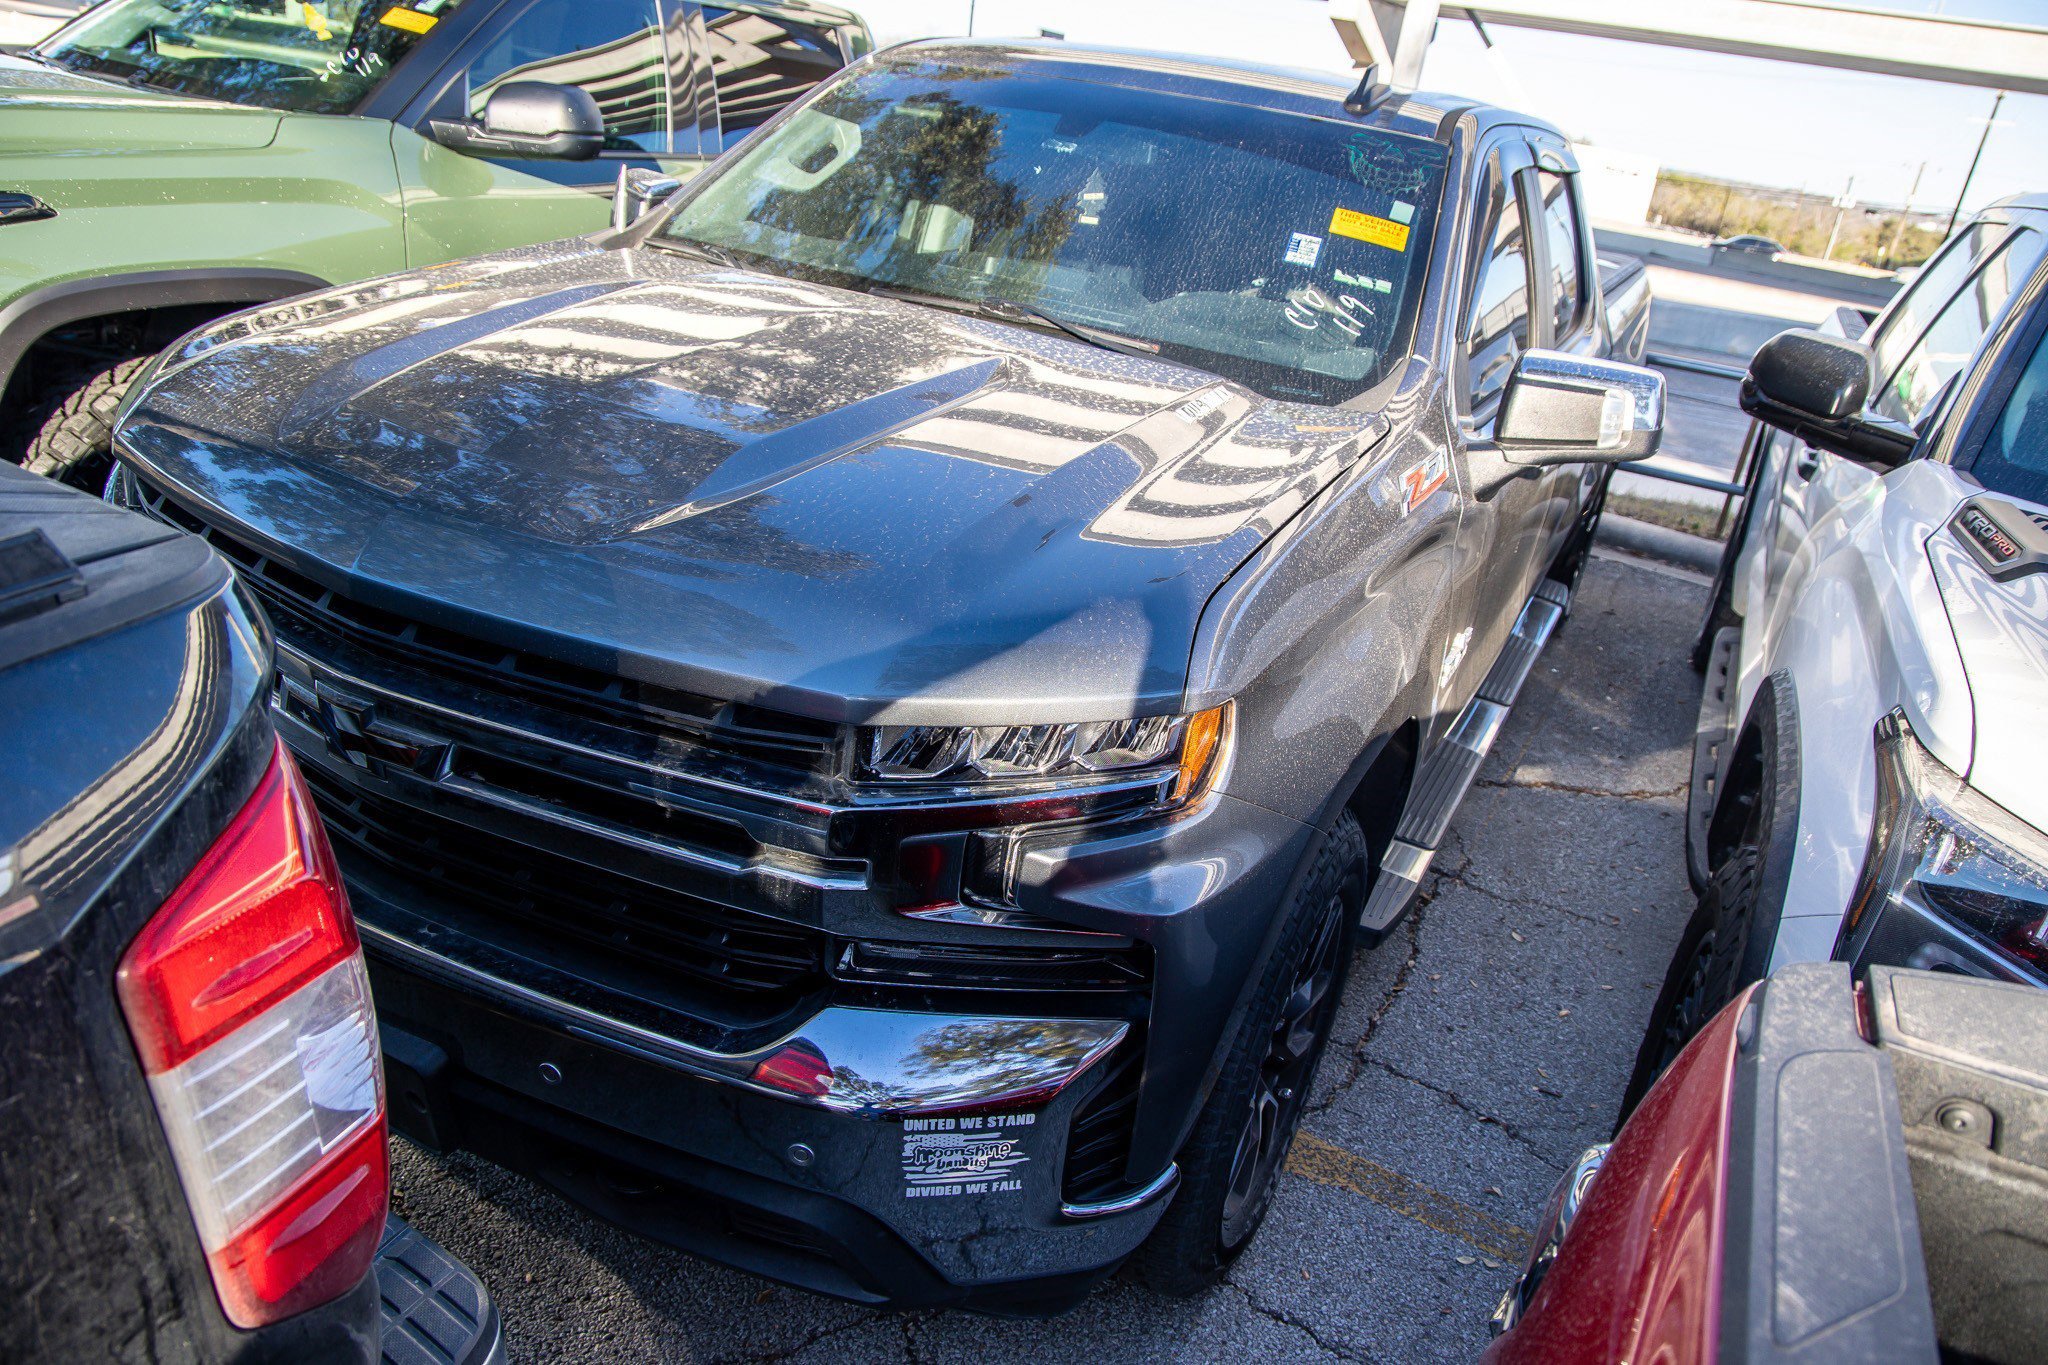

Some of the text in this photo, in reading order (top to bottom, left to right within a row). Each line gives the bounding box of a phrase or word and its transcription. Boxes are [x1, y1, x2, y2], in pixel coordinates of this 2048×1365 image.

[1340, 211, 1406, 232] THIS VEHICLE
[1379, 227, 1402, 237] SALE
[1990, 533, 2016, 557] PRO
[903, 1113, 1036, 1131] UNITED WE STAND
[905, 1179, 1022, 1197] DIVIDED WE FALL
